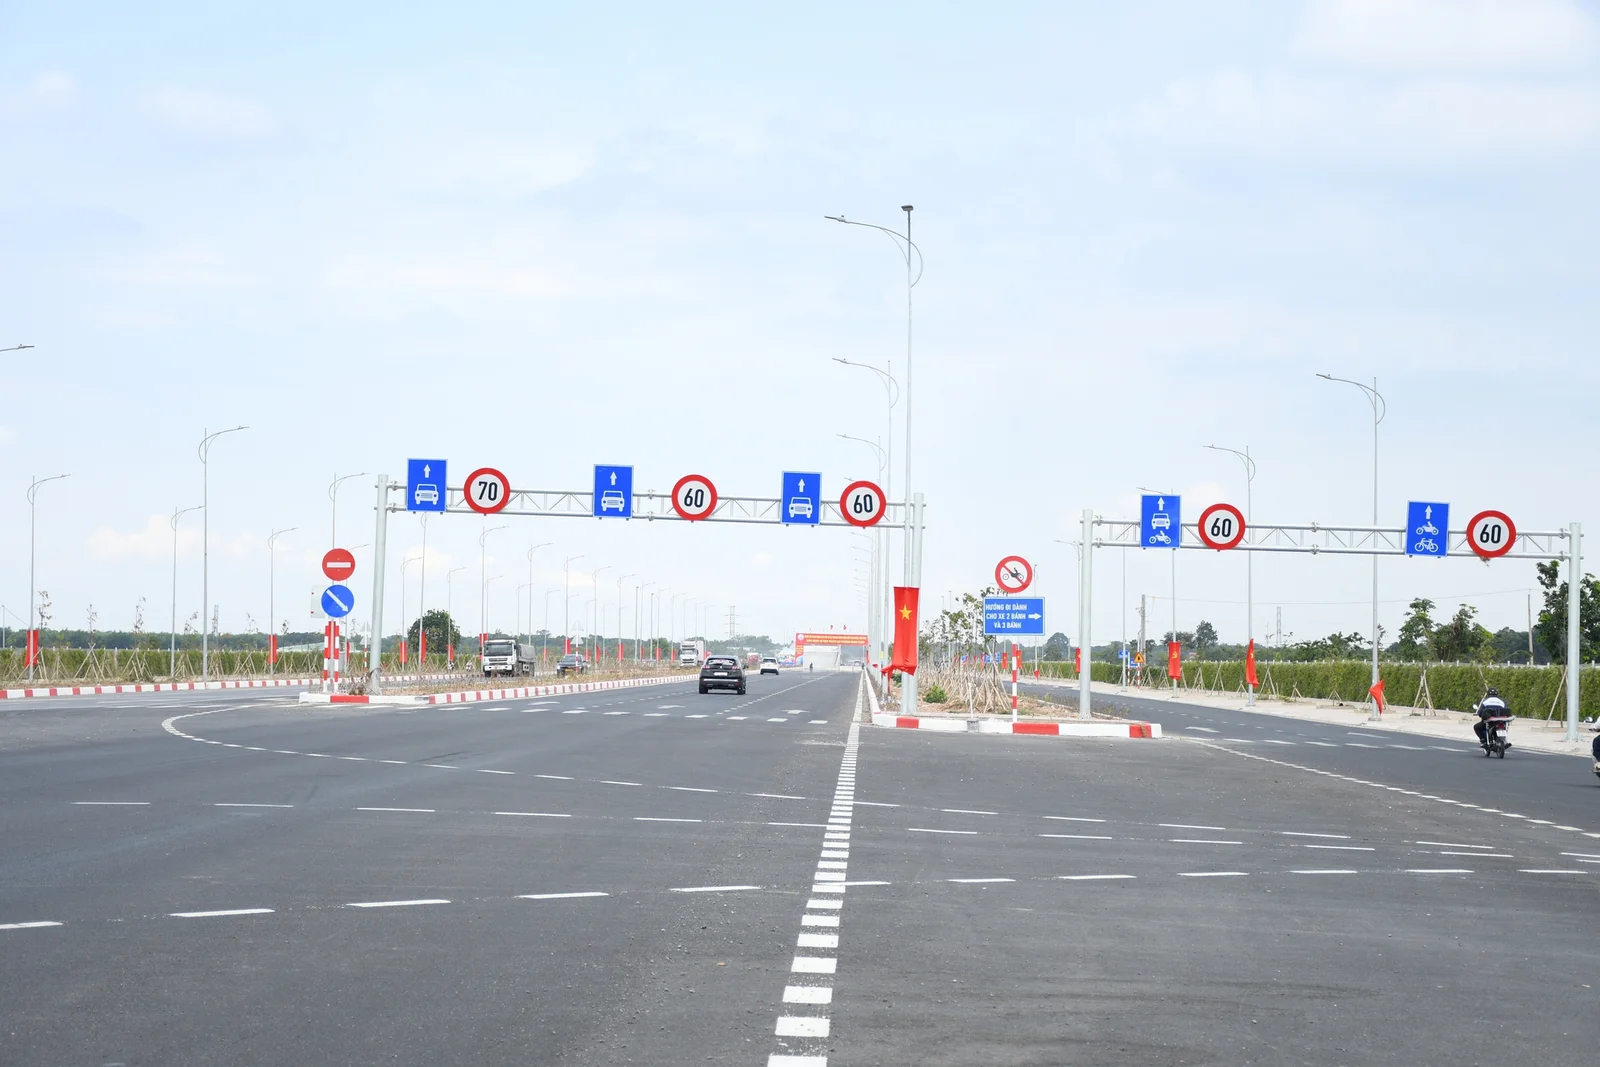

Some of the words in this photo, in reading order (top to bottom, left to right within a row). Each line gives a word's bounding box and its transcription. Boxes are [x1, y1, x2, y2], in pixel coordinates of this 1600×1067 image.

[478, 481, 498, 502] 70
[683, 488, 705, 508] 60
[853, 494, 874, 514] 60
[1210, 518, 1232, 538] 60
[1479, 524, 1502, 544] 60
[986, 602, 1004, 610] HƯỚNG
[1012, 602, 1028, 610] DÀNH
[1011, 612, 1026, 620] BÁNH
